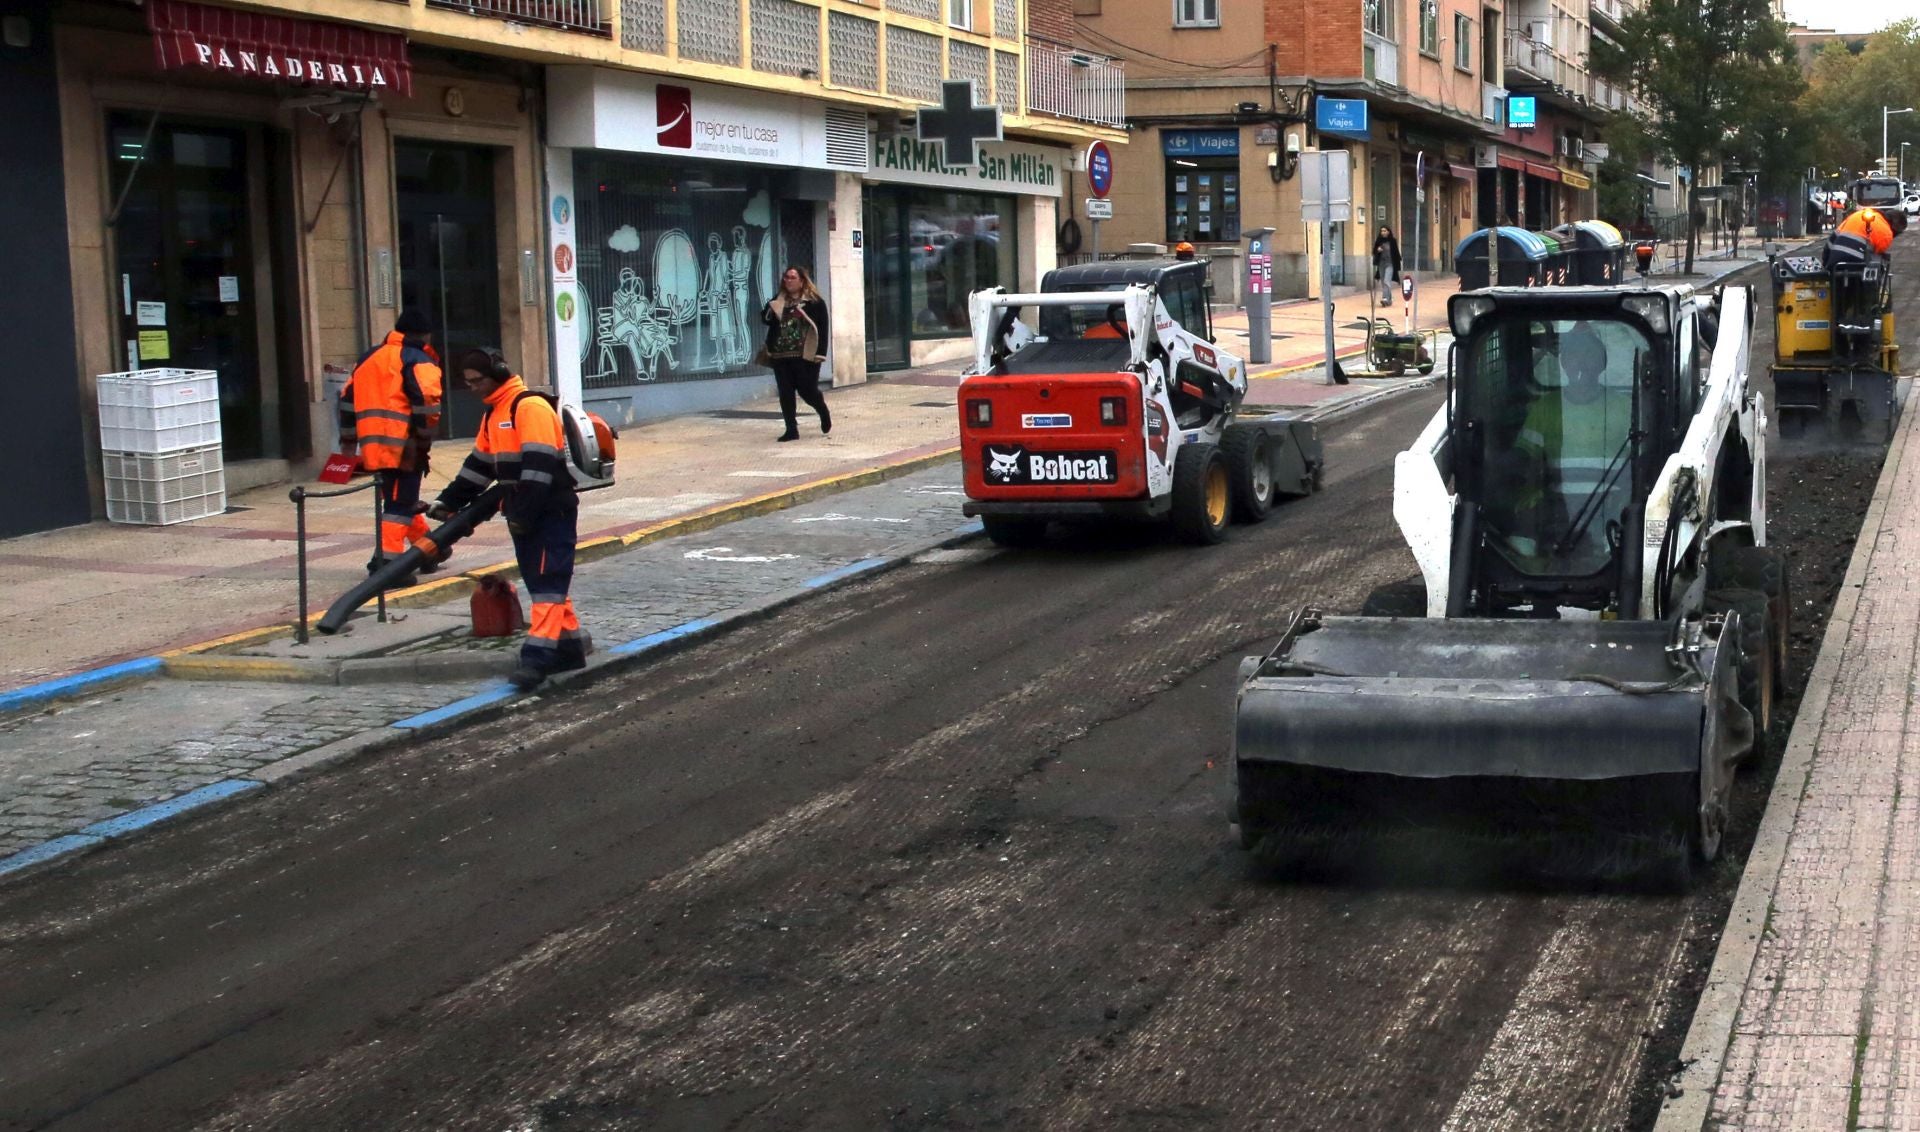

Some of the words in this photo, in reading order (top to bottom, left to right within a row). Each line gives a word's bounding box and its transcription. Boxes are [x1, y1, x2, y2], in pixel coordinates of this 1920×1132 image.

[195, 43, 386, 85] PANADERIA
[696, 119, 726, 141] mejor
[727, 124, 740, 138] en
[742, 124, 753, 140] tu
[754, 127, 778, 142] casa
[1329, 117, 1354, 128] Viajes
[1200, 136, 1236, 149] Viajes
[978, 149, 1006, 181] San
[1010, 152, 1054, 186] Millán
[1253, 240, 1261, 253] P
[1029, 455, 1109, 481] Bobcat
